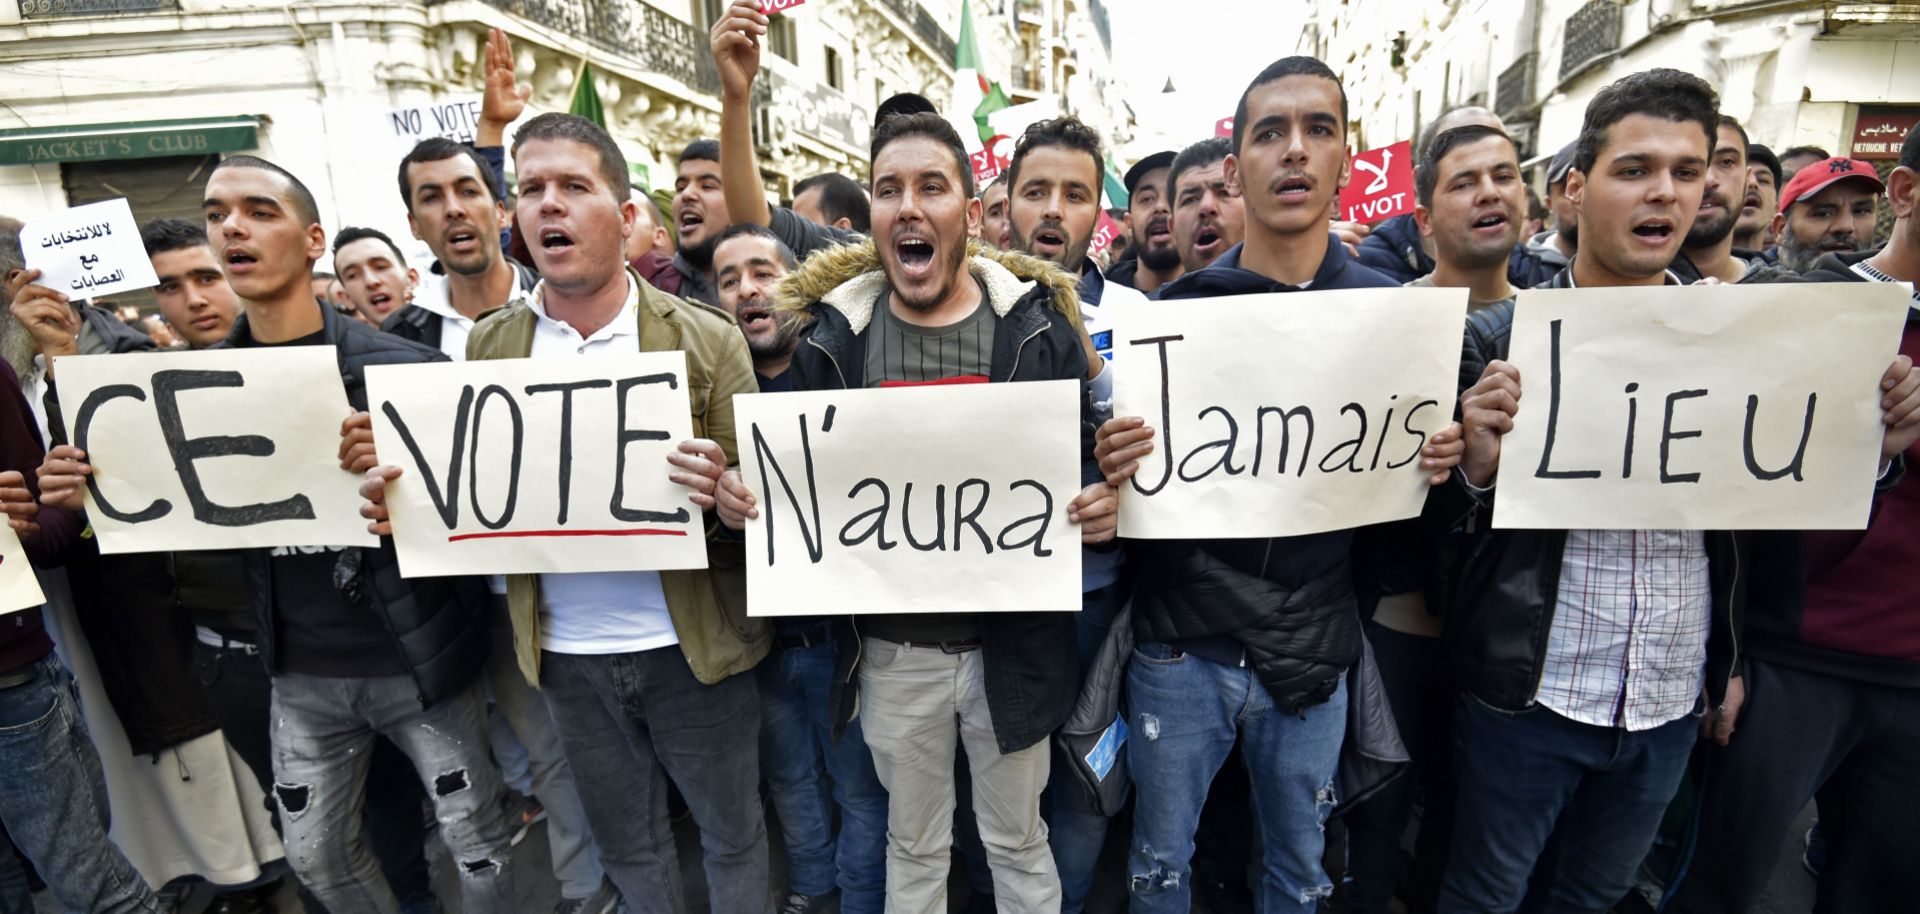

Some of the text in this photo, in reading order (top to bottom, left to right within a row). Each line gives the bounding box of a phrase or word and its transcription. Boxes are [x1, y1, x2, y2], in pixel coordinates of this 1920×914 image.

[392, 101, 482, 136] NO VOTE
[26, 135, 208, 161] JACKET'S CLUB
[1853, 142, 1888, 153] RETOUCHE
[79, 253, 99, 270] مع
[71, 268, 125, 291] العصابات
[1129, 334, 1439, 497] Jamais
[74, 369, 316, 527] CE
[381, 372, 691, 530] VOTE
